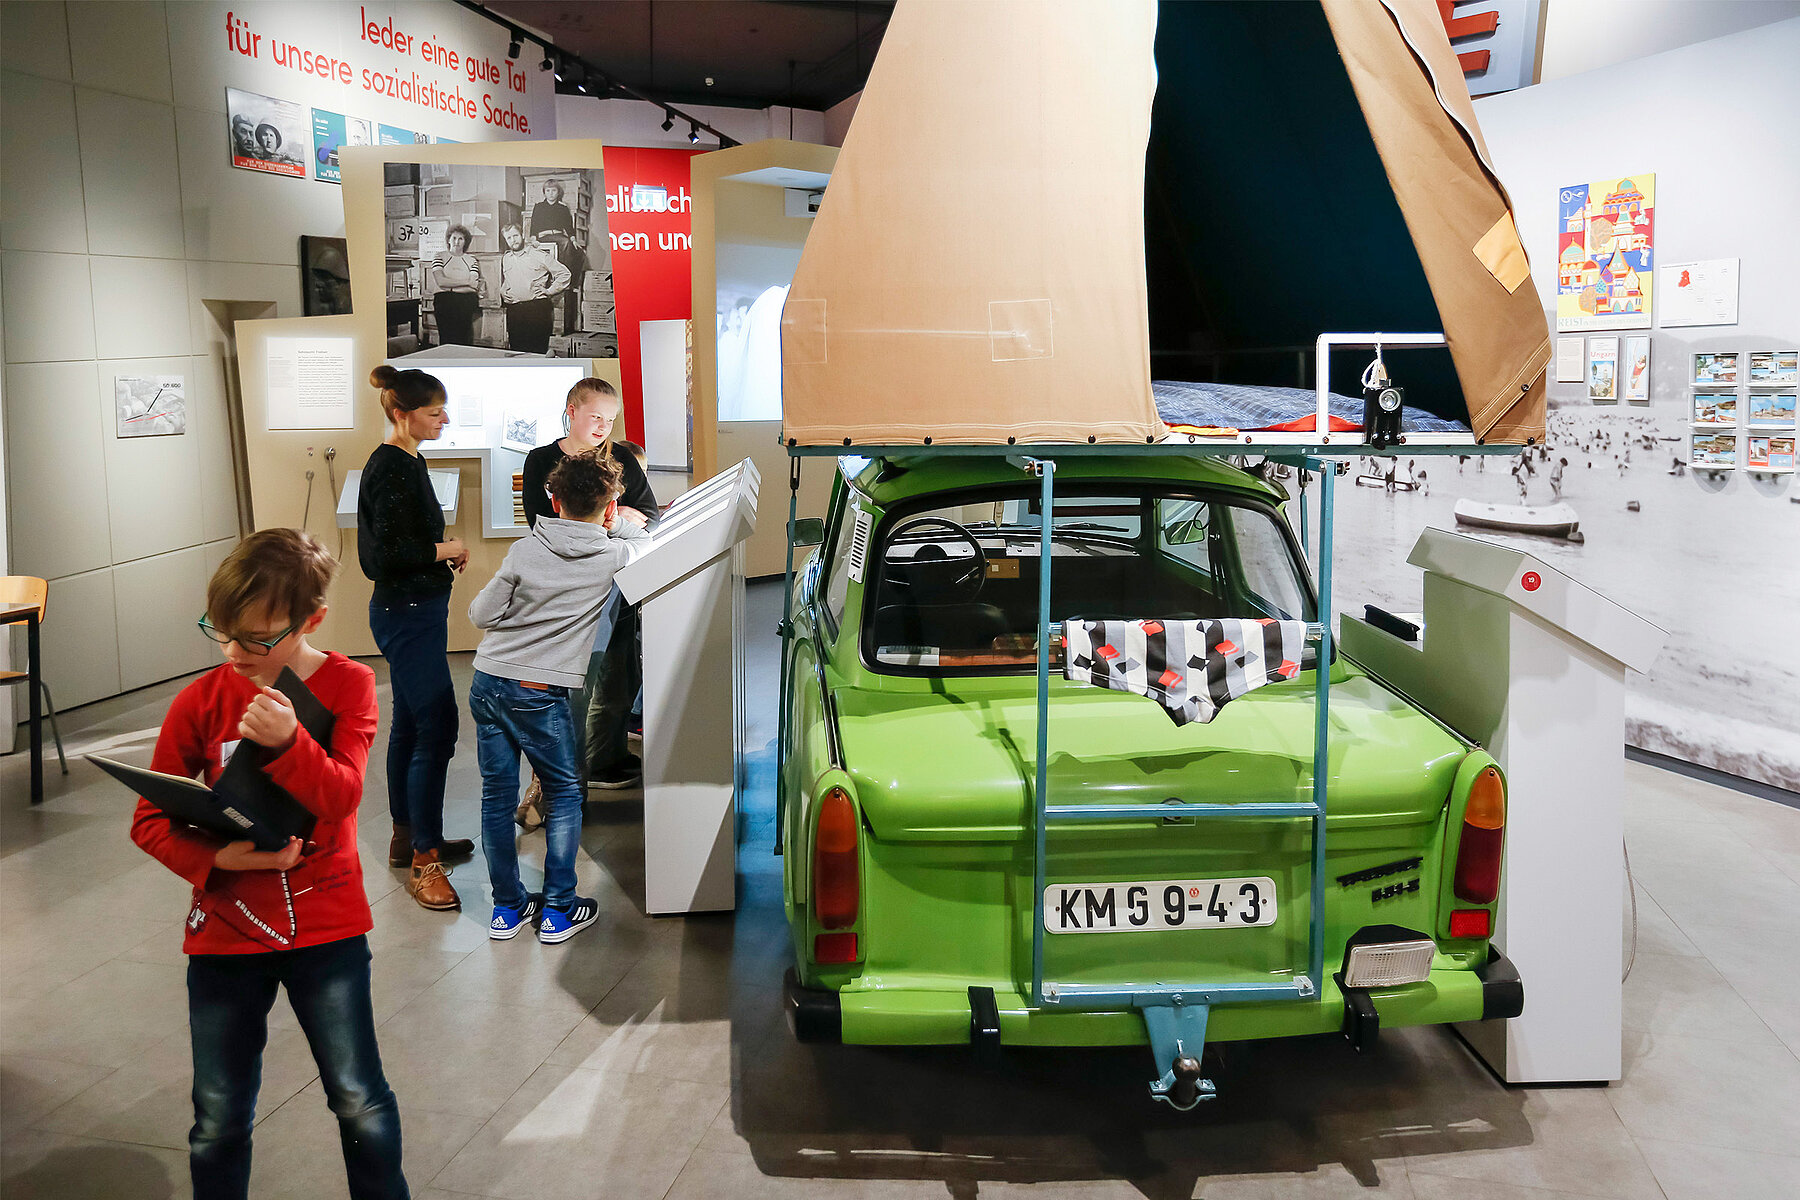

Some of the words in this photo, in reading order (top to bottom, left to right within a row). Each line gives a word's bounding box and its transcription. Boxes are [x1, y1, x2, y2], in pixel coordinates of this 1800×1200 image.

[225, 11, 262, 59] für
[271, 39, 353, 85] unsere
[362, 67, 477, 120] sozialistische
[482, 93, 531, 135] Sache.
[360, 5, 414, 56] Jeder
[421, 34, 459, 71] eine
[465, 56, 500, 85] gute
[504, 59, 527, 94] Tat
[398, 224, 415, 241] 37
[658, 232, 692, 251] un
